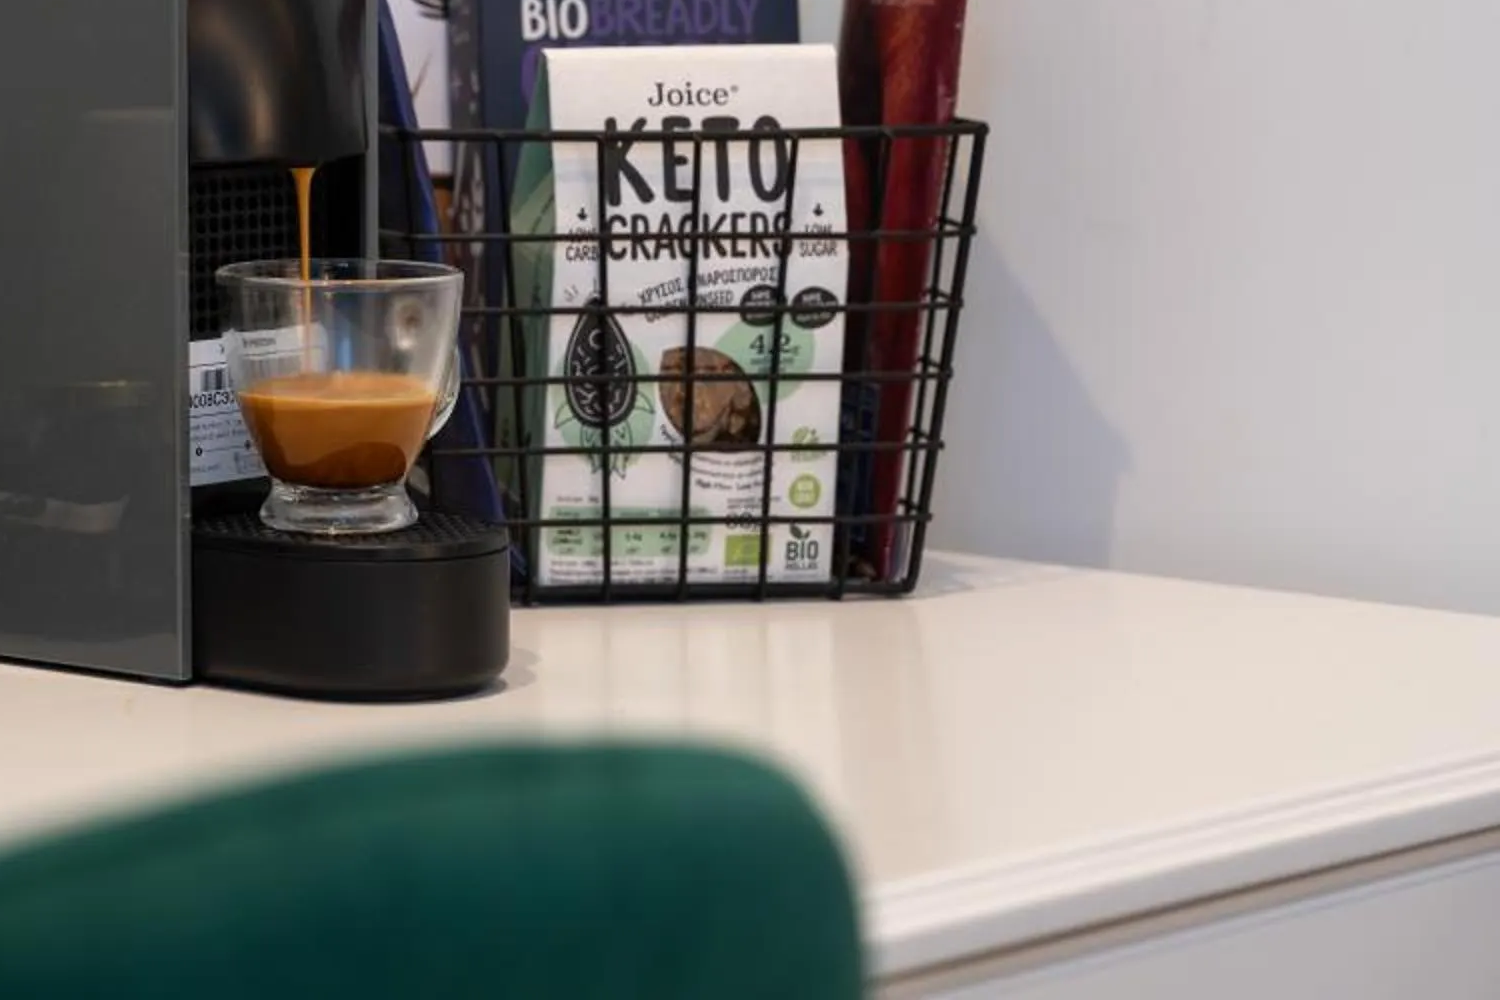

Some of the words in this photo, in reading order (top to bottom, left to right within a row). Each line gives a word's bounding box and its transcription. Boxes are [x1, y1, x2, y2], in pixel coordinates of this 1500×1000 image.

[604, 115, 790, 207] KETO
[605, 211, 793, 261] CRACKERS
[785, 540, 819, 562] BIO
